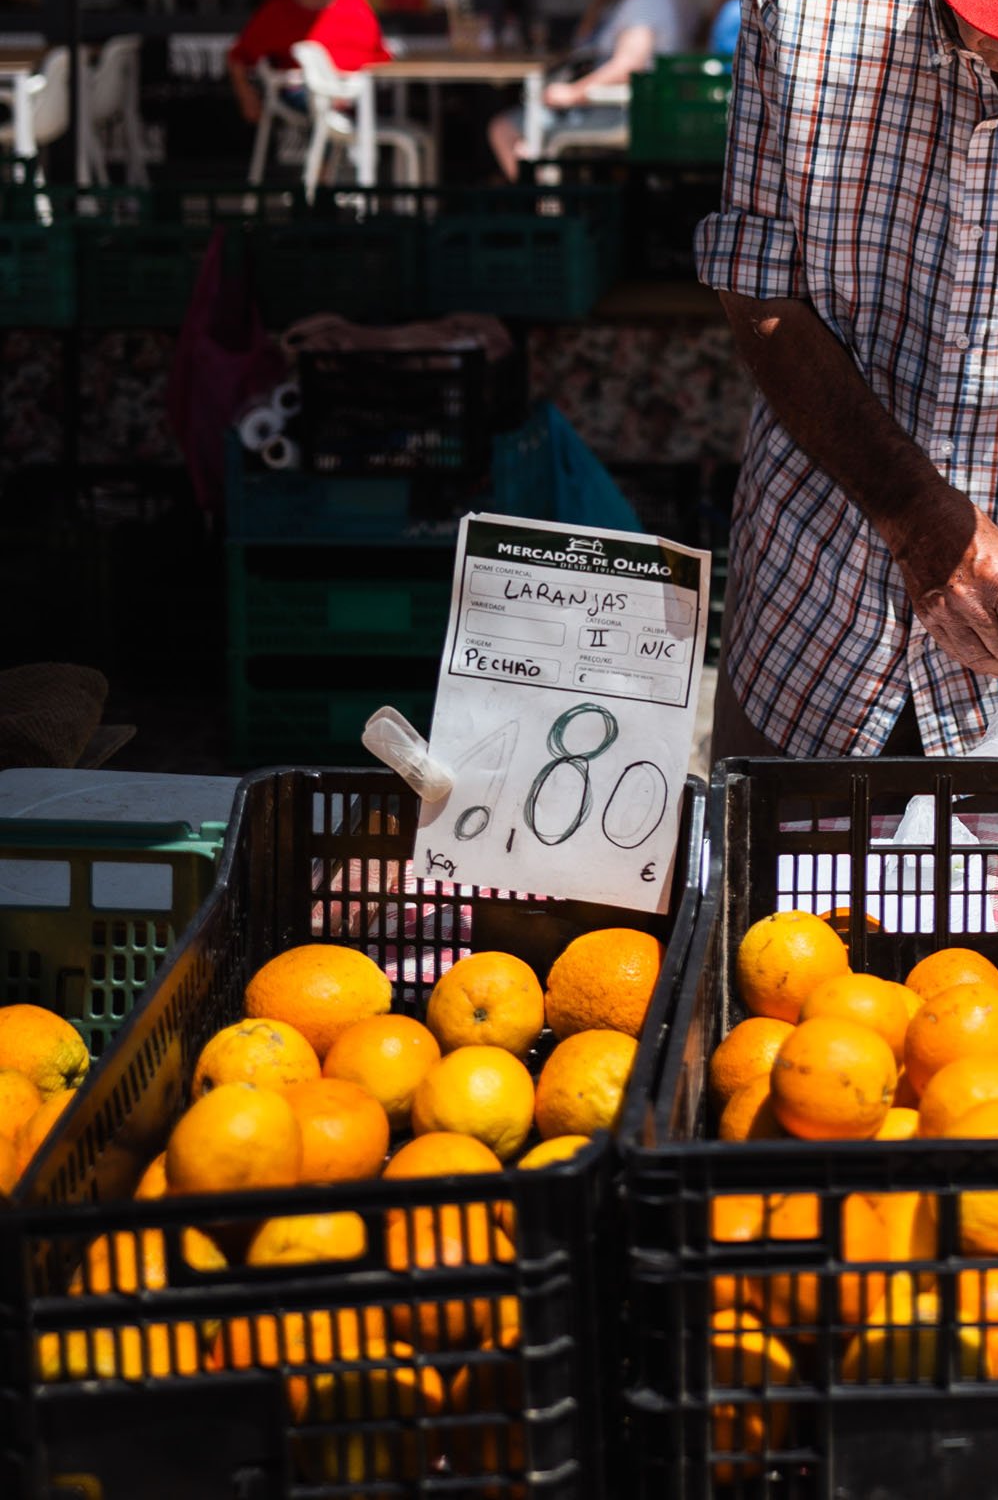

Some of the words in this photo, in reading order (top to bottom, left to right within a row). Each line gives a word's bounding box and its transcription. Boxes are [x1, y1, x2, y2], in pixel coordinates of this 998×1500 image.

[498, 543, 588, 565] MERCADOS
[593, 558, 608, 568] DE
[614, 558, 673, 577] OLHÃO
[560, 562, 592, 573] DESDE
[473, 563, 494, 573] NOME
[495, 566, 533, 578] COMERCIAL
[470, 601, 507, 612] VARIEDADE
[504, 579, 628, 617] LARANJAS
[585, 616, 623, 627] CATEGORIA
[465, 638, 493, 648] ORIGEM
[640, 640, 676, 660] N/C
[465, 648, 541, 677] PECHÃO
[640, 862, 656, 882] €
